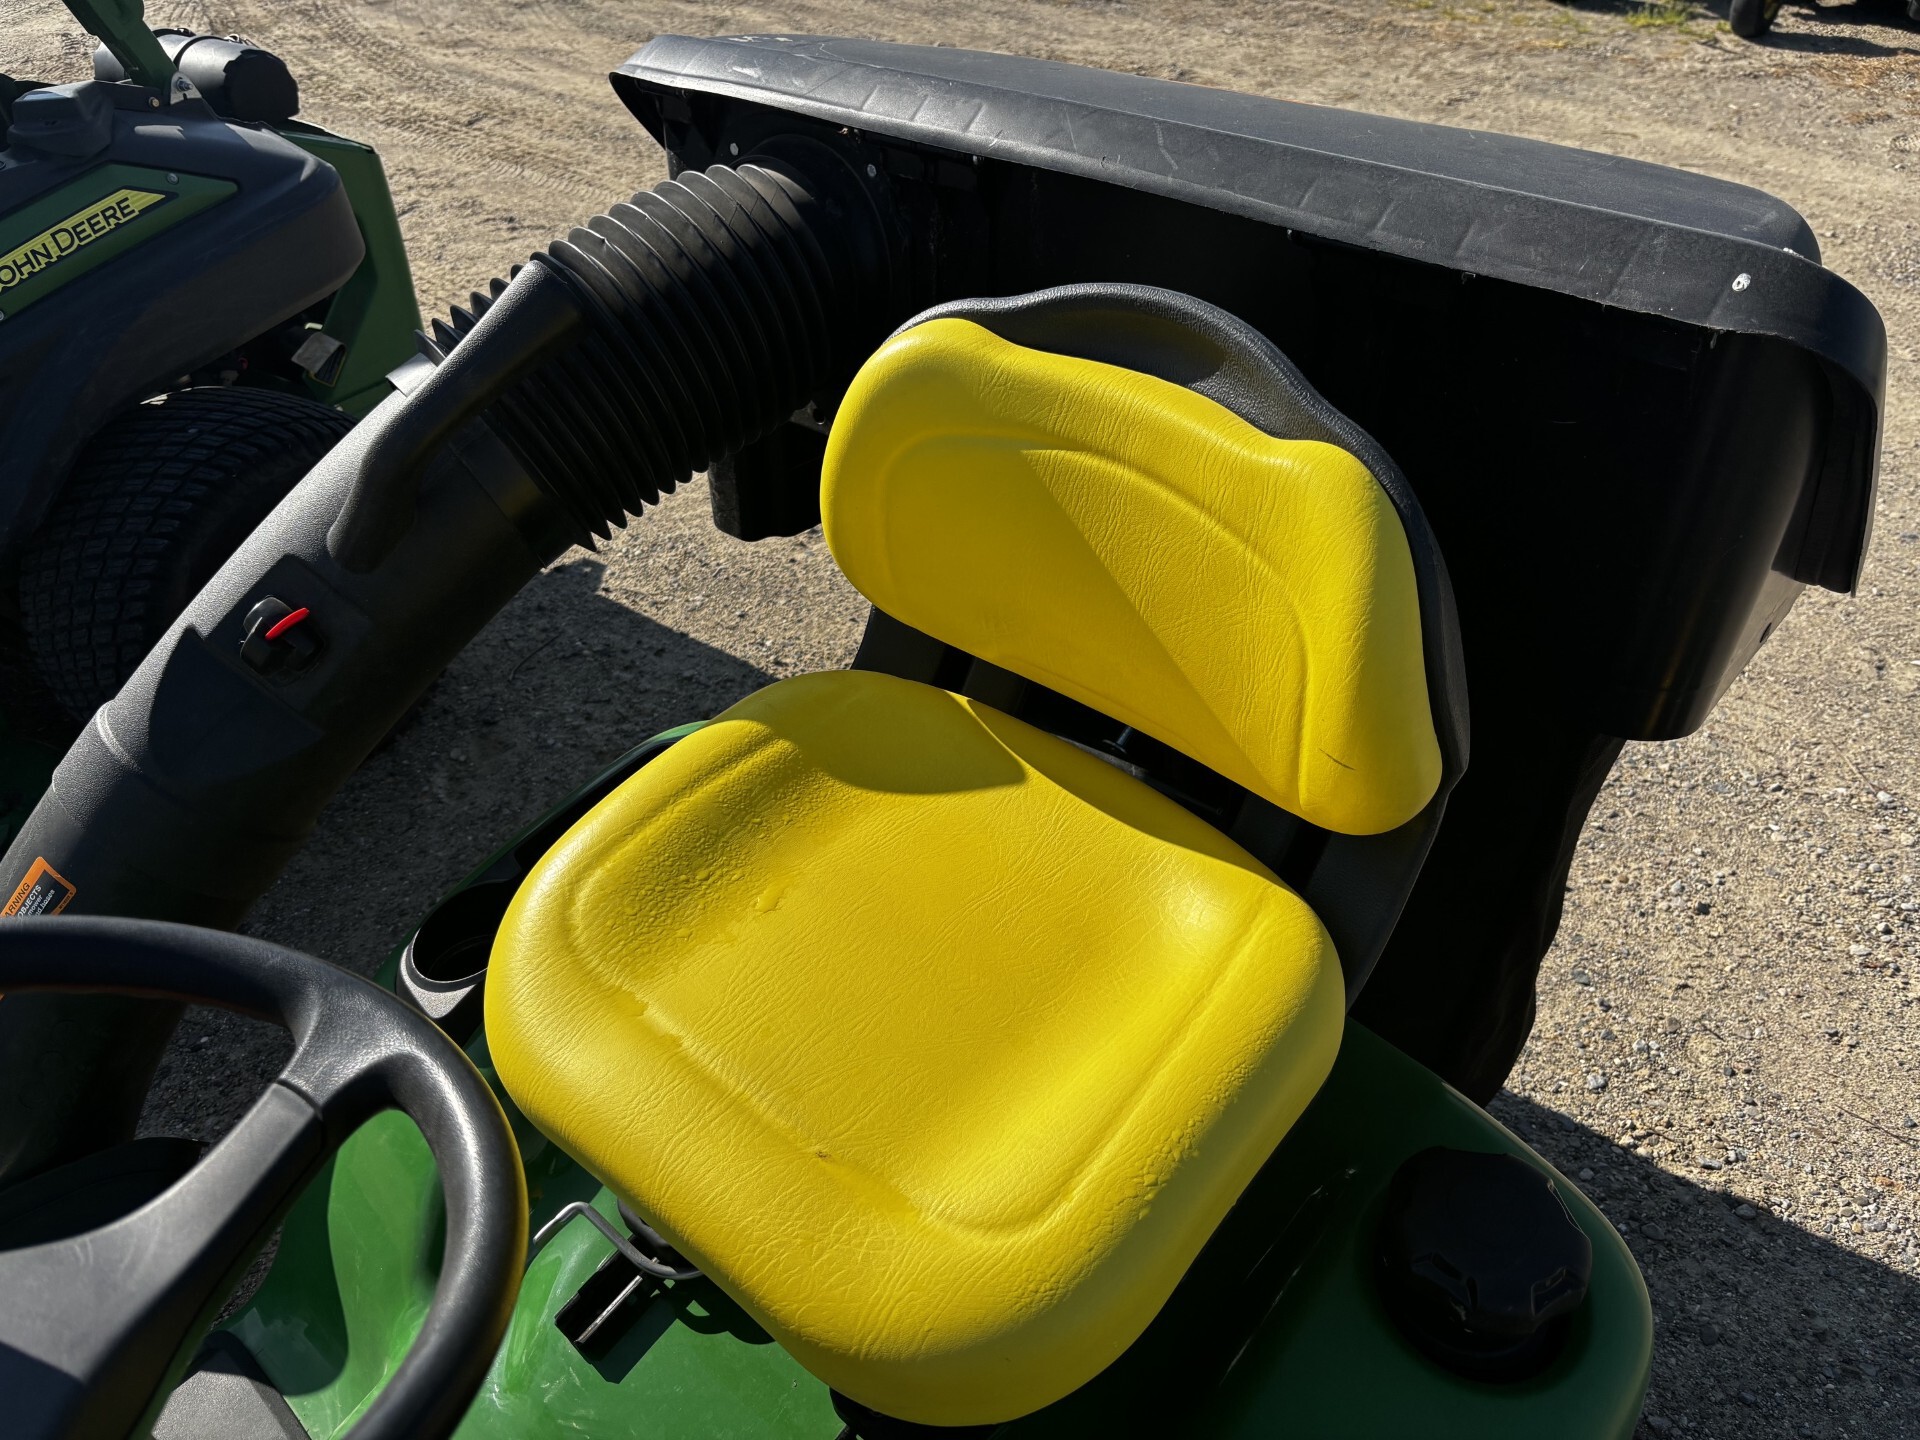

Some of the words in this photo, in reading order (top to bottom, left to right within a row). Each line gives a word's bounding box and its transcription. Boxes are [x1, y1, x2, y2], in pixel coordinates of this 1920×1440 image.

[0, 243, 53, 285] OHN
[50, 197, 136, 254] DEERE
[5, 882, 31, 917] ARNING
[17, 884, 42, 918] OBJECTS
